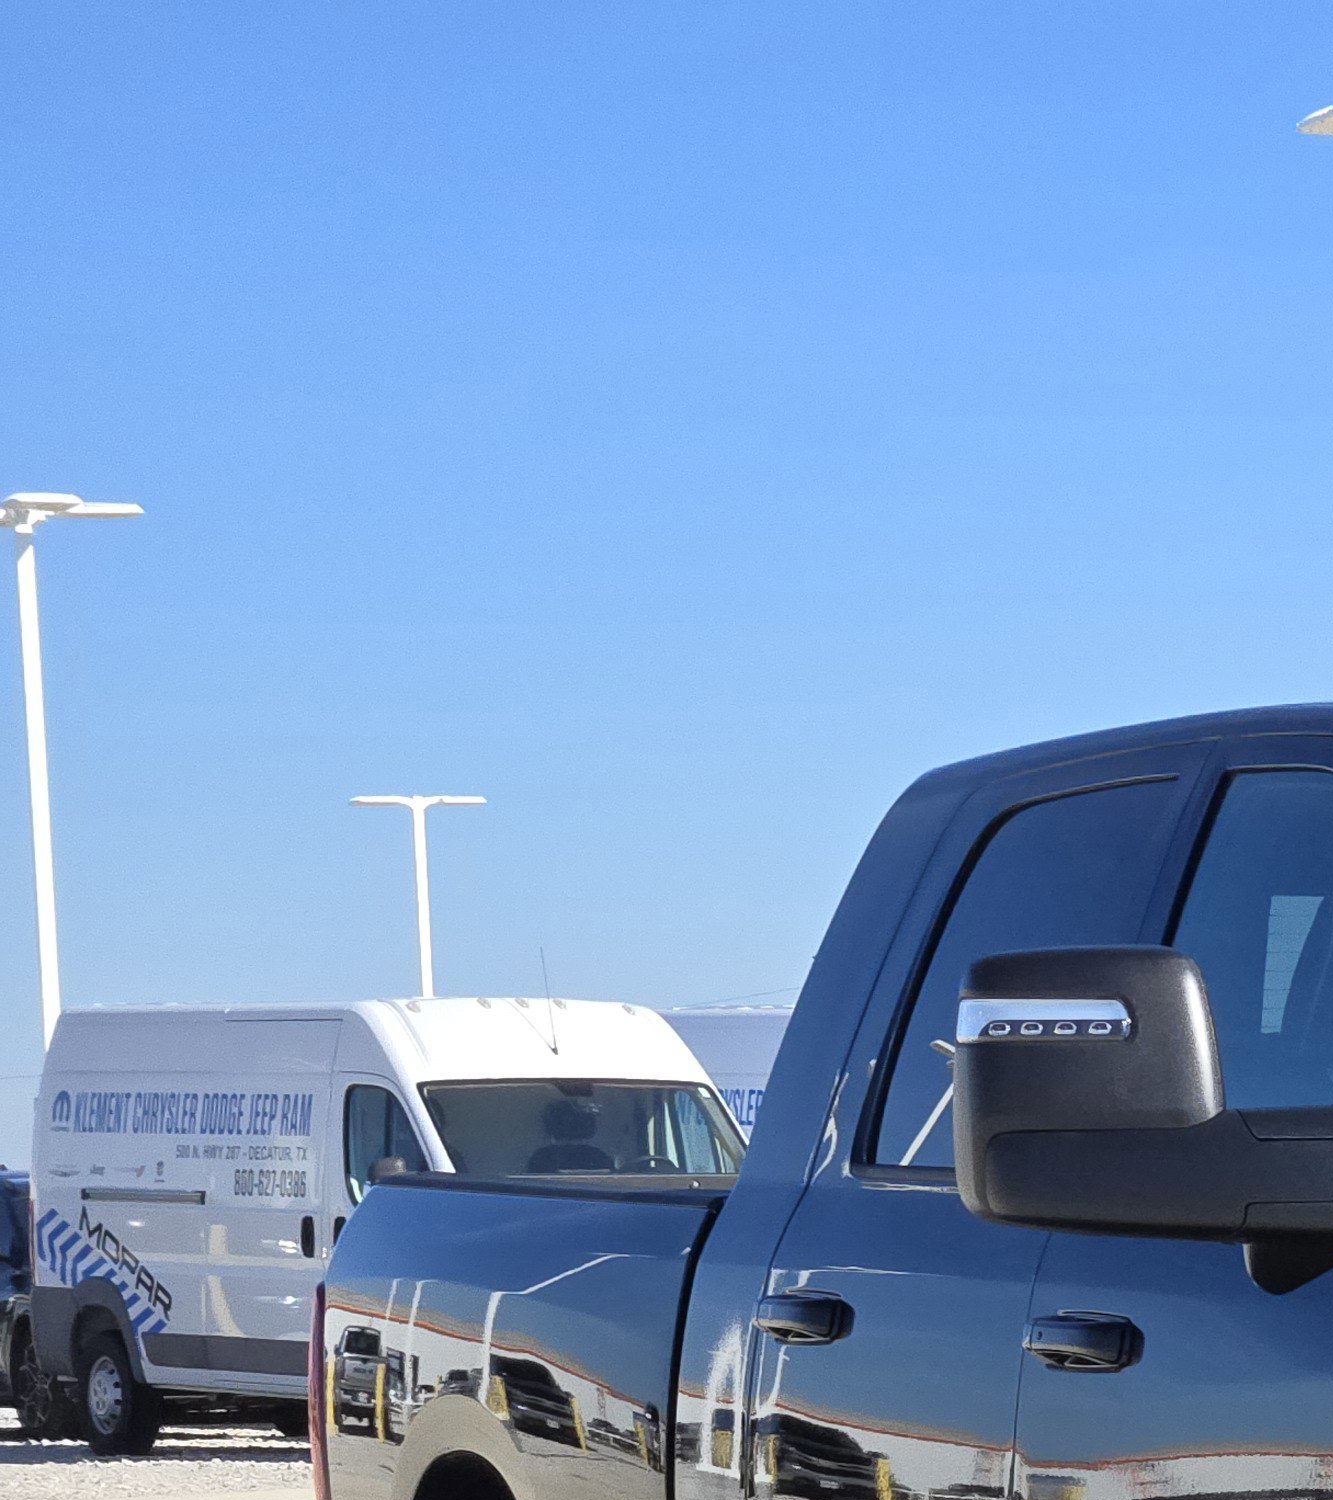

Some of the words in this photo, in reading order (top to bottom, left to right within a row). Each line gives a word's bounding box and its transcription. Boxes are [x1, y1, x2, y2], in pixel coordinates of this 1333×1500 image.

[73, 1091, 132, 1134] KLEMENT
[132, 1092, 199, 1135] CHRYSLER
[200, 1093, 246, 1136] DODGE
[246, 1093, 279, 1136] JEEP
[279, 1094, 313, 1137] RAM
[296, 1146, 308, 1160] TX
[79, 1206, 173, 1322] MOPAR
